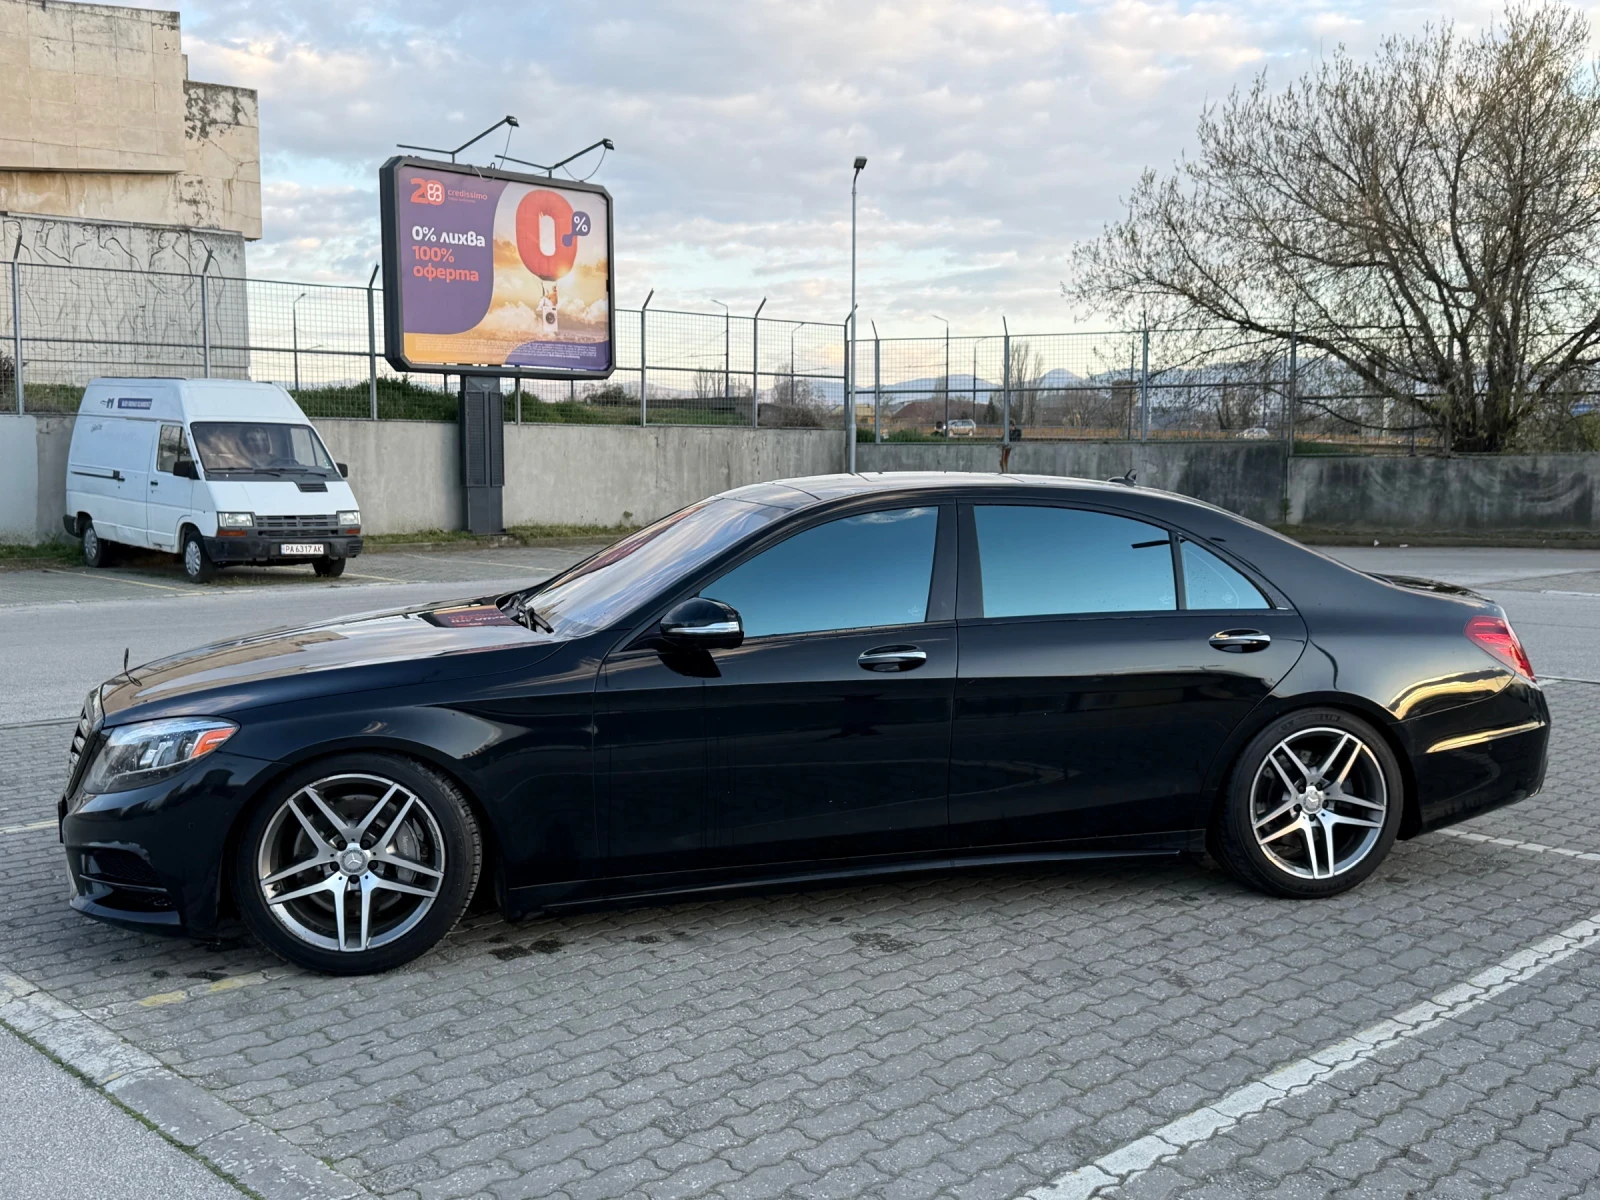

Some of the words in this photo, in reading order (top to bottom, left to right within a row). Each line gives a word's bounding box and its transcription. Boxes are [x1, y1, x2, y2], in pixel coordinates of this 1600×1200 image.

[447, 189, 488, 201] credissimo
[411, 225, 437, 243] 0%
[439, 230, 486, 248] лихва
[411, 245, 455, 263] 100%
[412, 262, 479, 283] оферта
[295, 545, 312, 553] 6317
[313, 545, 322, 553] AK
